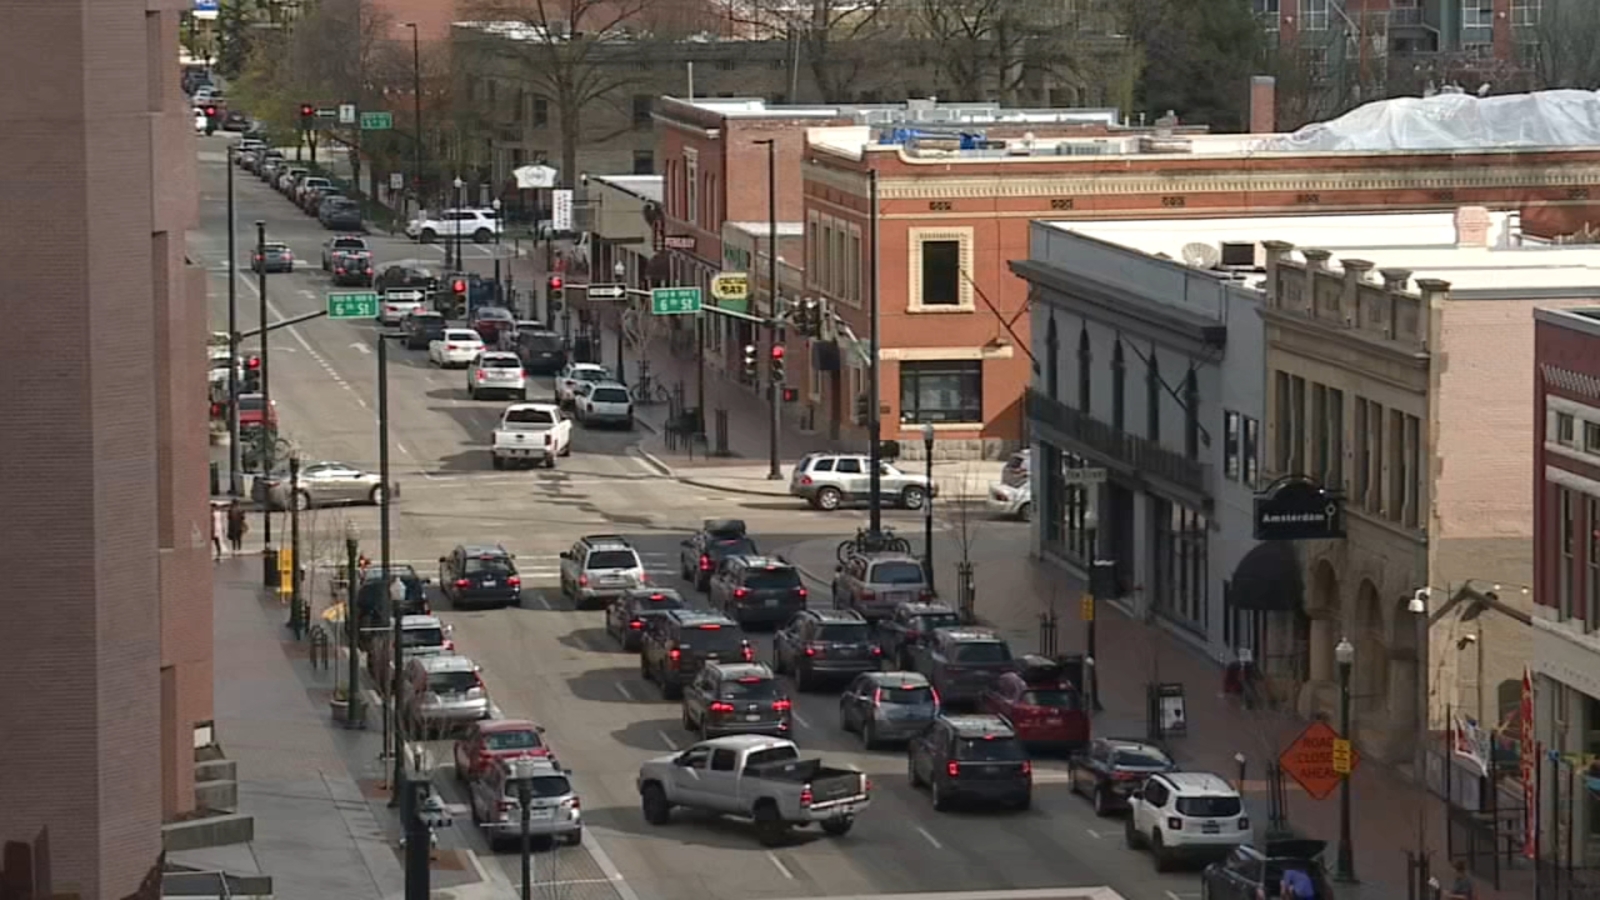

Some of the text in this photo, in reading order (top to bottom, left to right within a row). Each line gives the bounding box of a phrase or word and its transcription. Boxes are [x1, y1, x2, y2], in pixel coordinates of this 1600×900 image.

[721, 285, 744, 295] BAR
[1262, 512, 1325, 522] Amsterdam
[1298, 752, 1334, 763] CLOSE
